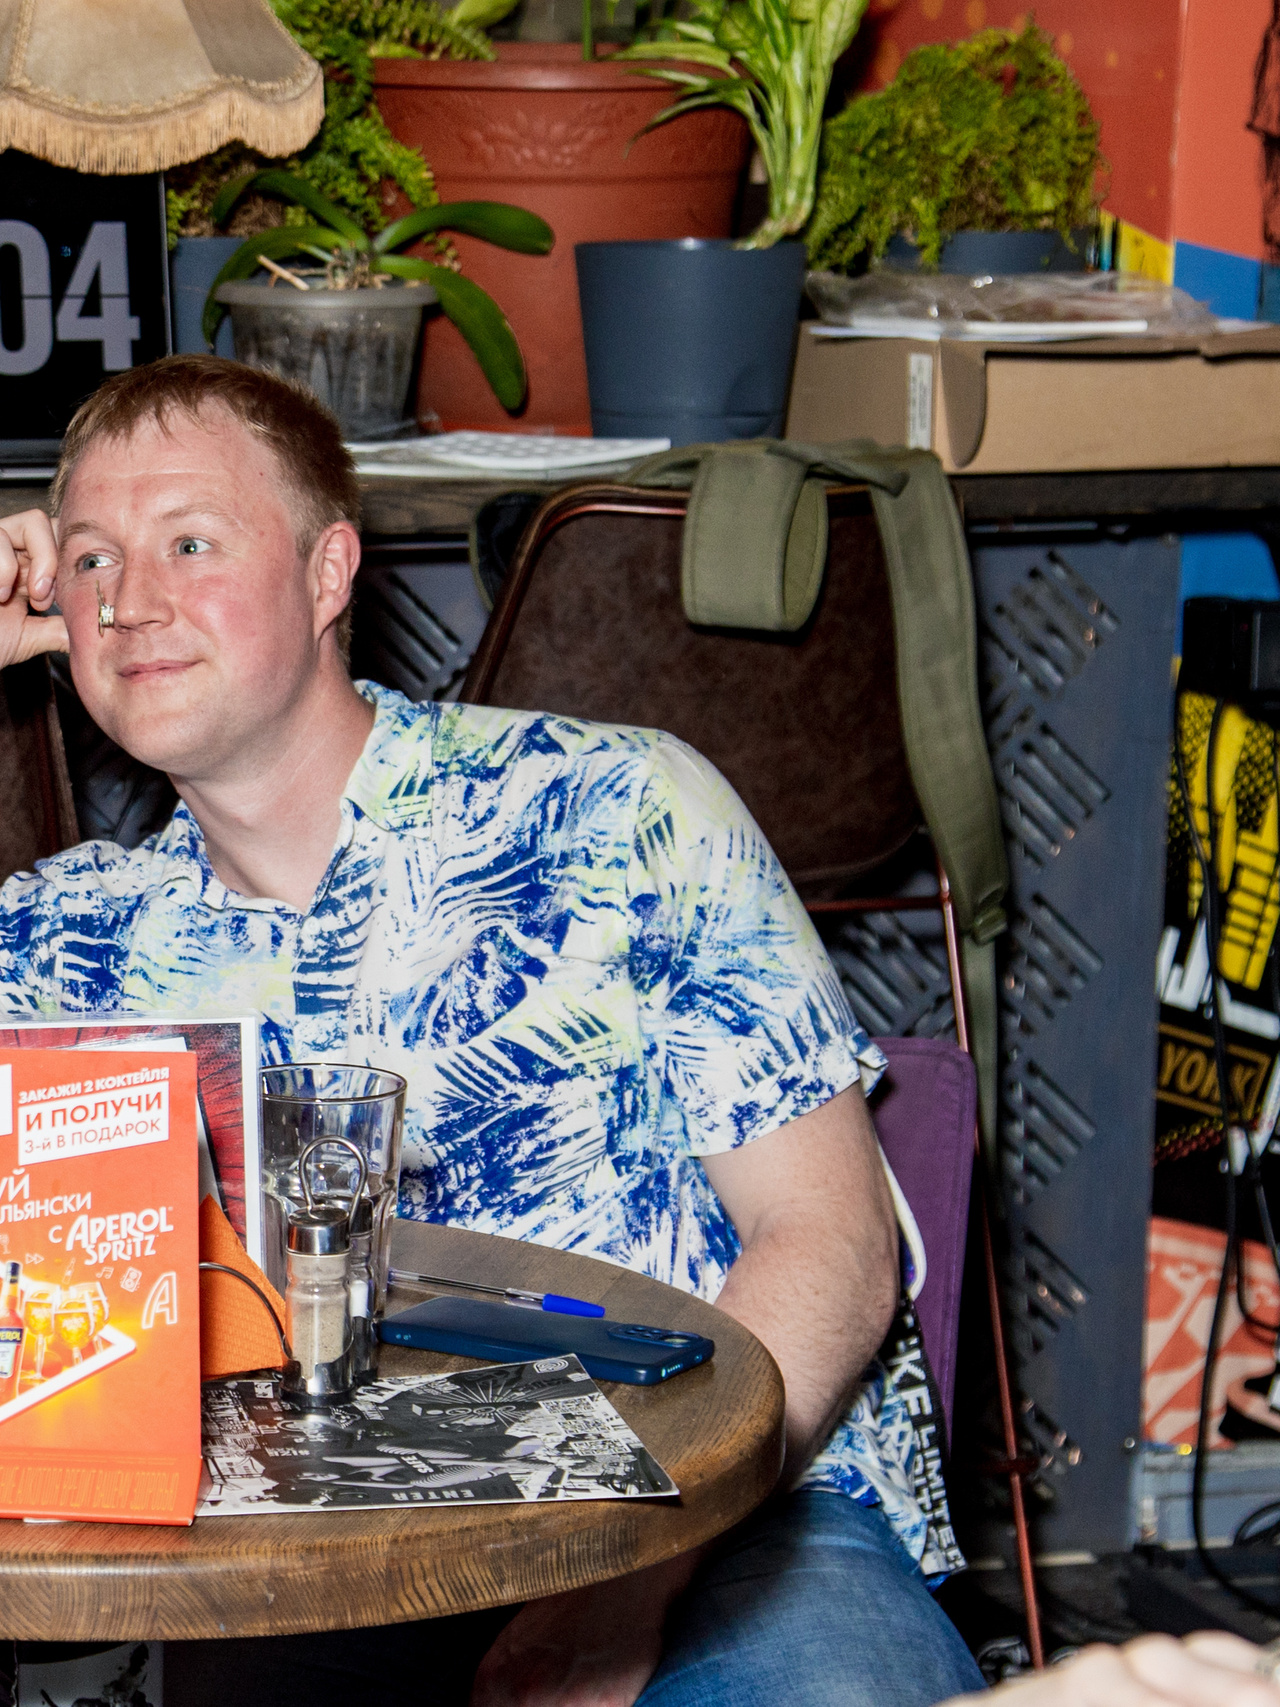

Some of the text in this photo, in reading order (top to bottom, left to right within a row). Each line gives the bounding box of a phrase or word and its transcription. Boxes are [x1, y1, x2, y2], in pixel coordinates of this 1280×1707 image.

[18, 1066, 170, 1104] ЗАКАЖИ 2 КОКТЕЙЛЯ
[26, 1091, 163, 1132] И ПОЛУЧИ
[24, 1117, 161, 1154] 3-й В ПОДАРОК
[65, 1206, 174, 1251] APEROL
[391, 1489, 475, 1501] ENTER
